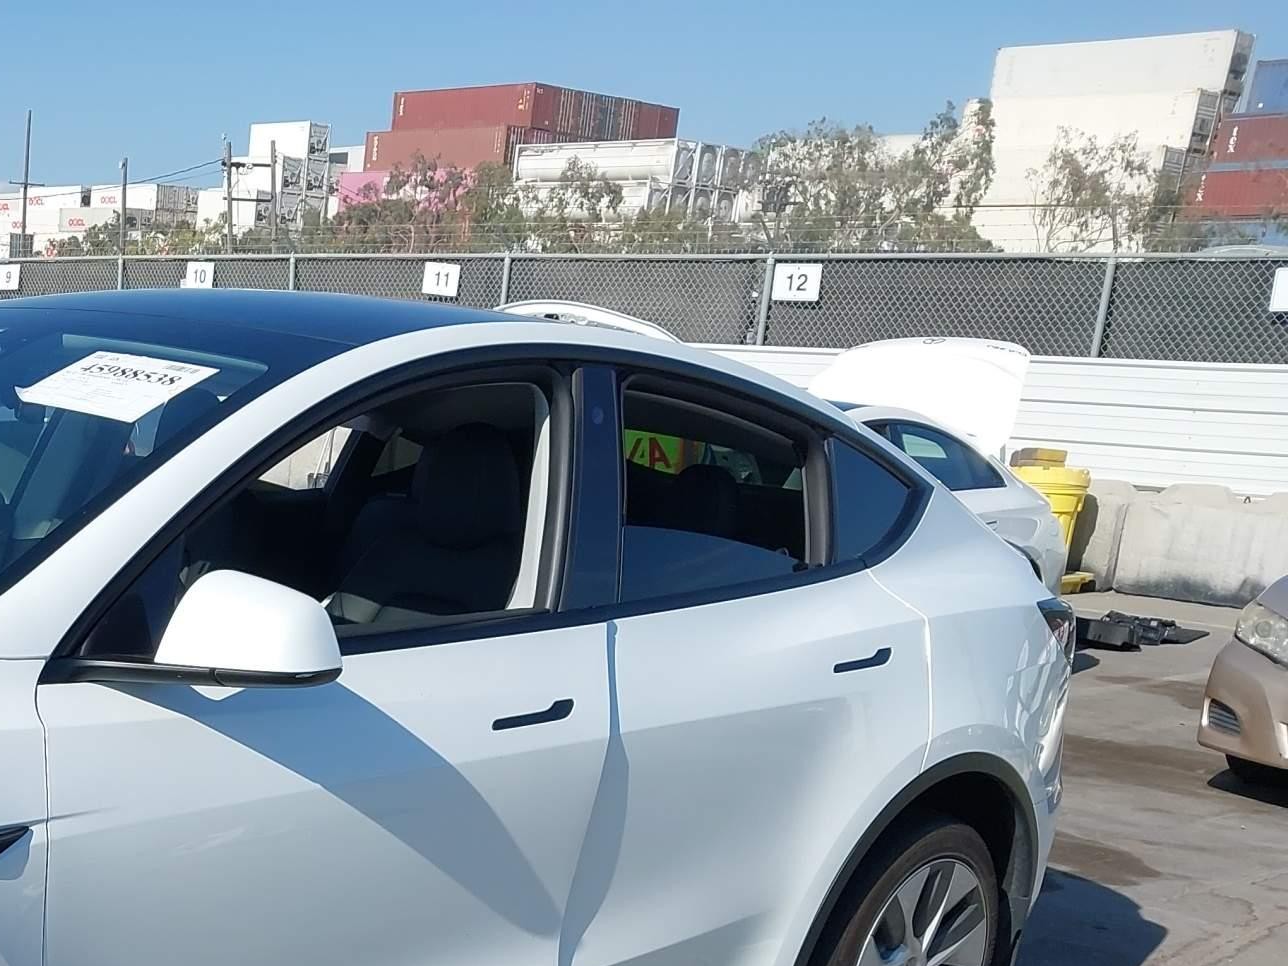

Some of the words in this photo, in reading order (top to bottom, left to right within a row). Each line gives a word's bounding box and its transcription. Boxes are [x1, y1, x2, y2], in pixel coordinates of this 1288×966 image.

[5, 271, 11, 283] 9
[193, 269, 207, 283] 10
[434, 271, 450, 288] 11
[787, 273, 808, 291] 12
[80, 363, 183, 386] 45988538
